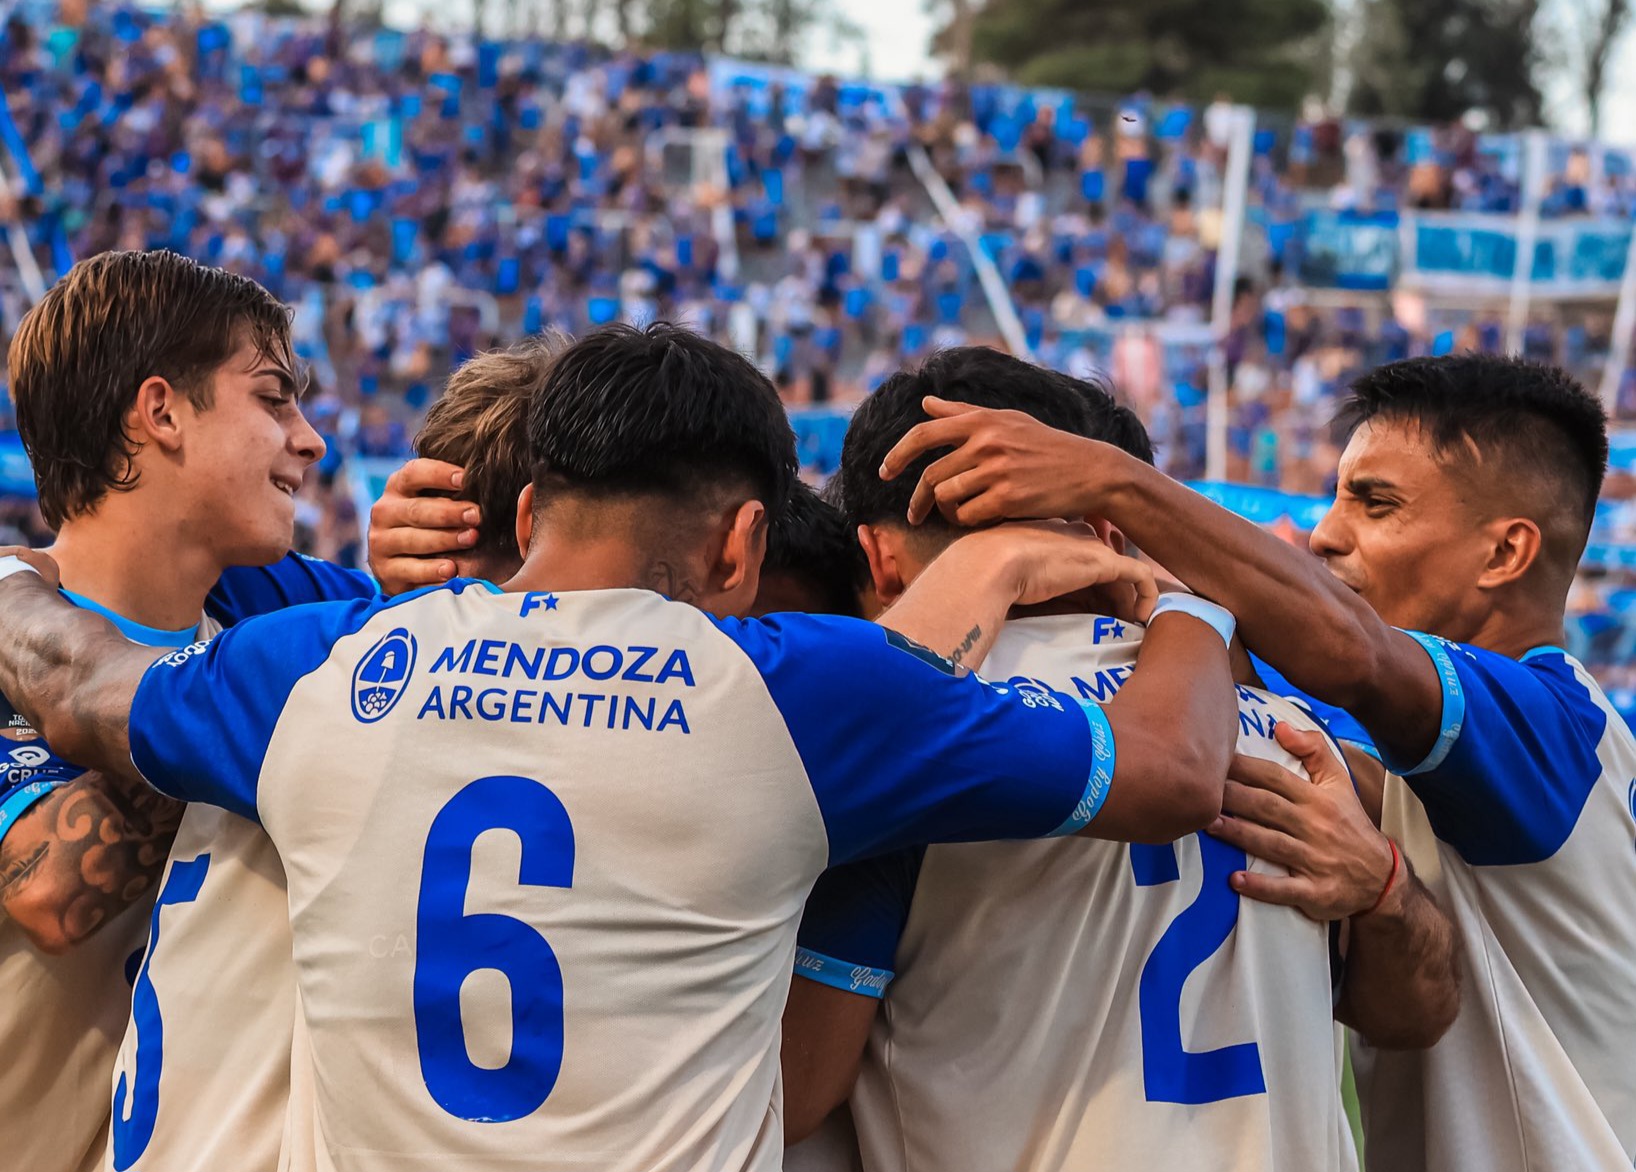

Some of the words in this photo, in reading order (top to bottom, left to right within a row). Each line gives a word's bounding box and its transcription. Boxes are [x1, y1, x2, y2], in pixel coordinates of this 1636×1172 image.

[518, 591, 550, 618] F
[1092, 617, 1115, 645] F
[428, 639, 696, 687] MENDOZA
[416, 685, 691, 734] ARGENTINA
[1072, 766, 1111, 822] Godoy
[413, 775, 575, 1123] 6
[1129, 829, 1267, 1105] 2
